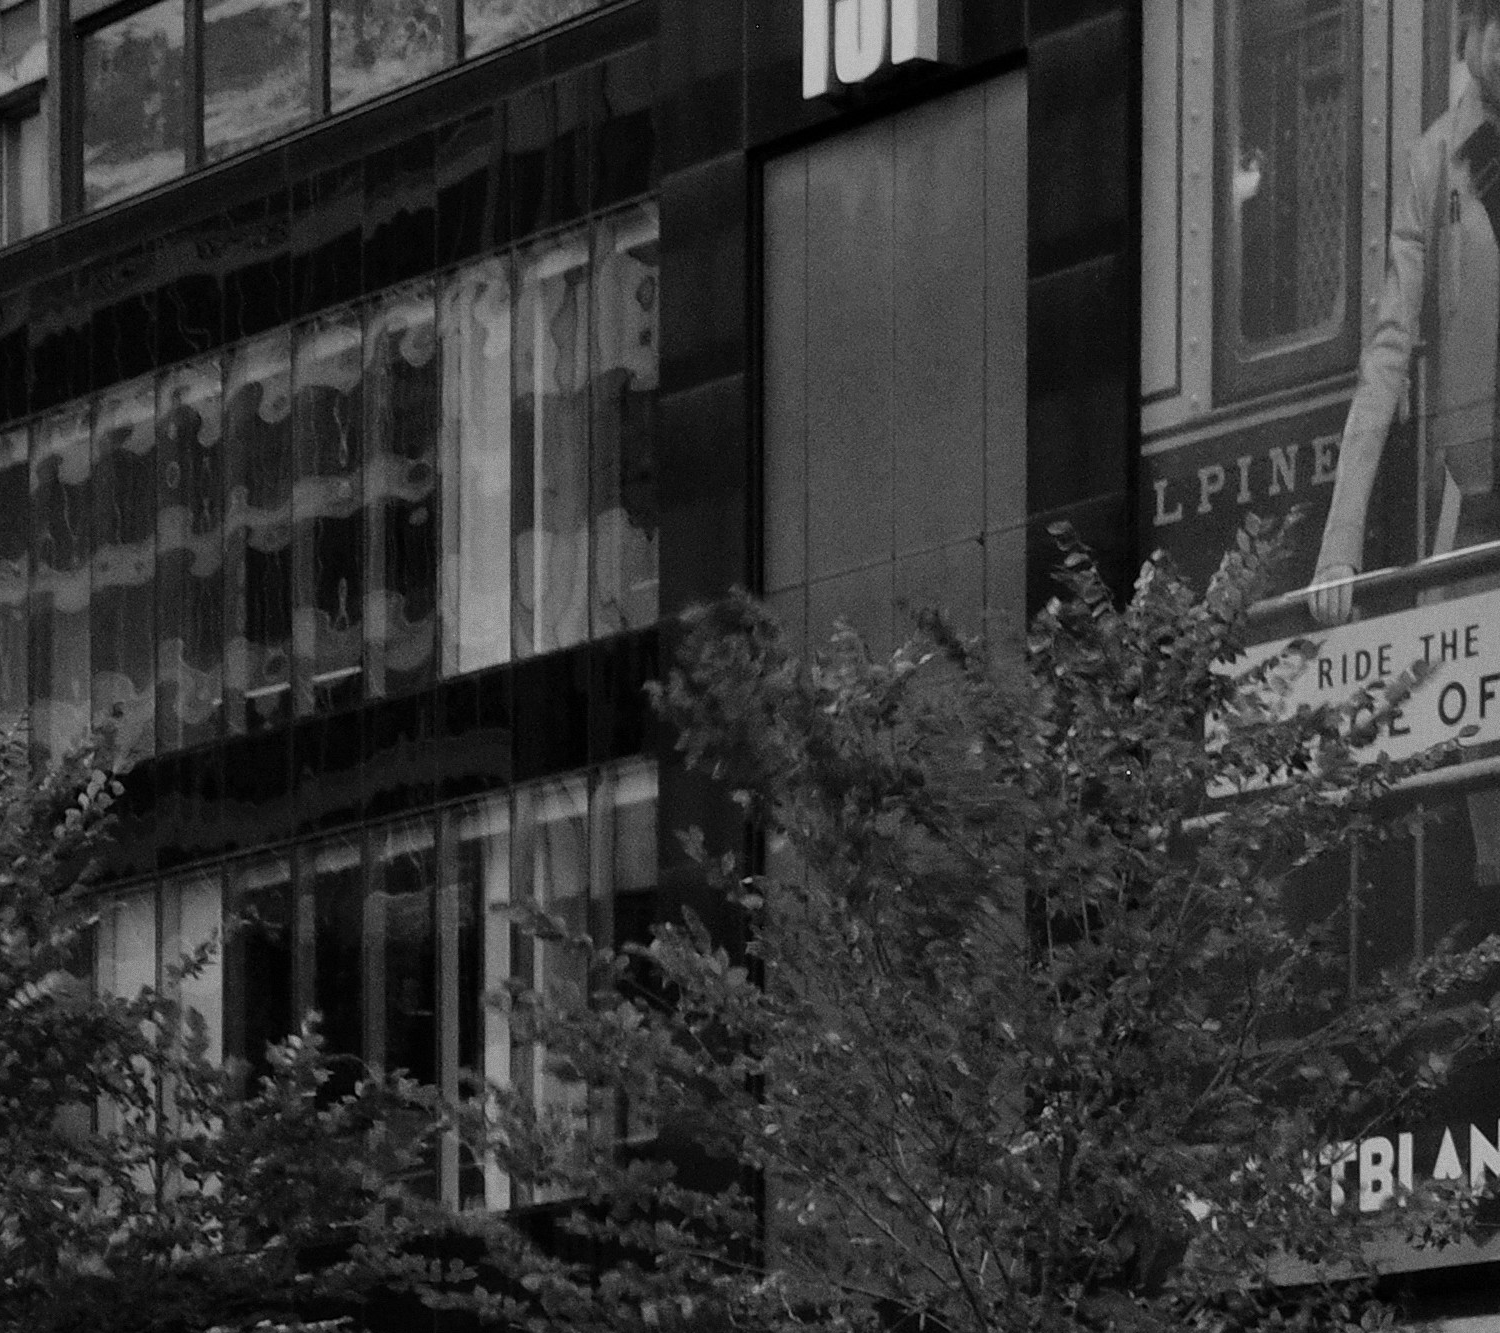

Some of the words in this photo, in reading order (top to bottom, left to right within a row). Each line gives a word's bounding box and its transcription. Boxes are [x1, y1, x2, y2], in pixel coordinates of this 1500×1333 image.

[1317, 643, 1393, 690] RIDE
[1419, 624, 1480, 664] THE
[1437, 672, 1500, 726] OF
